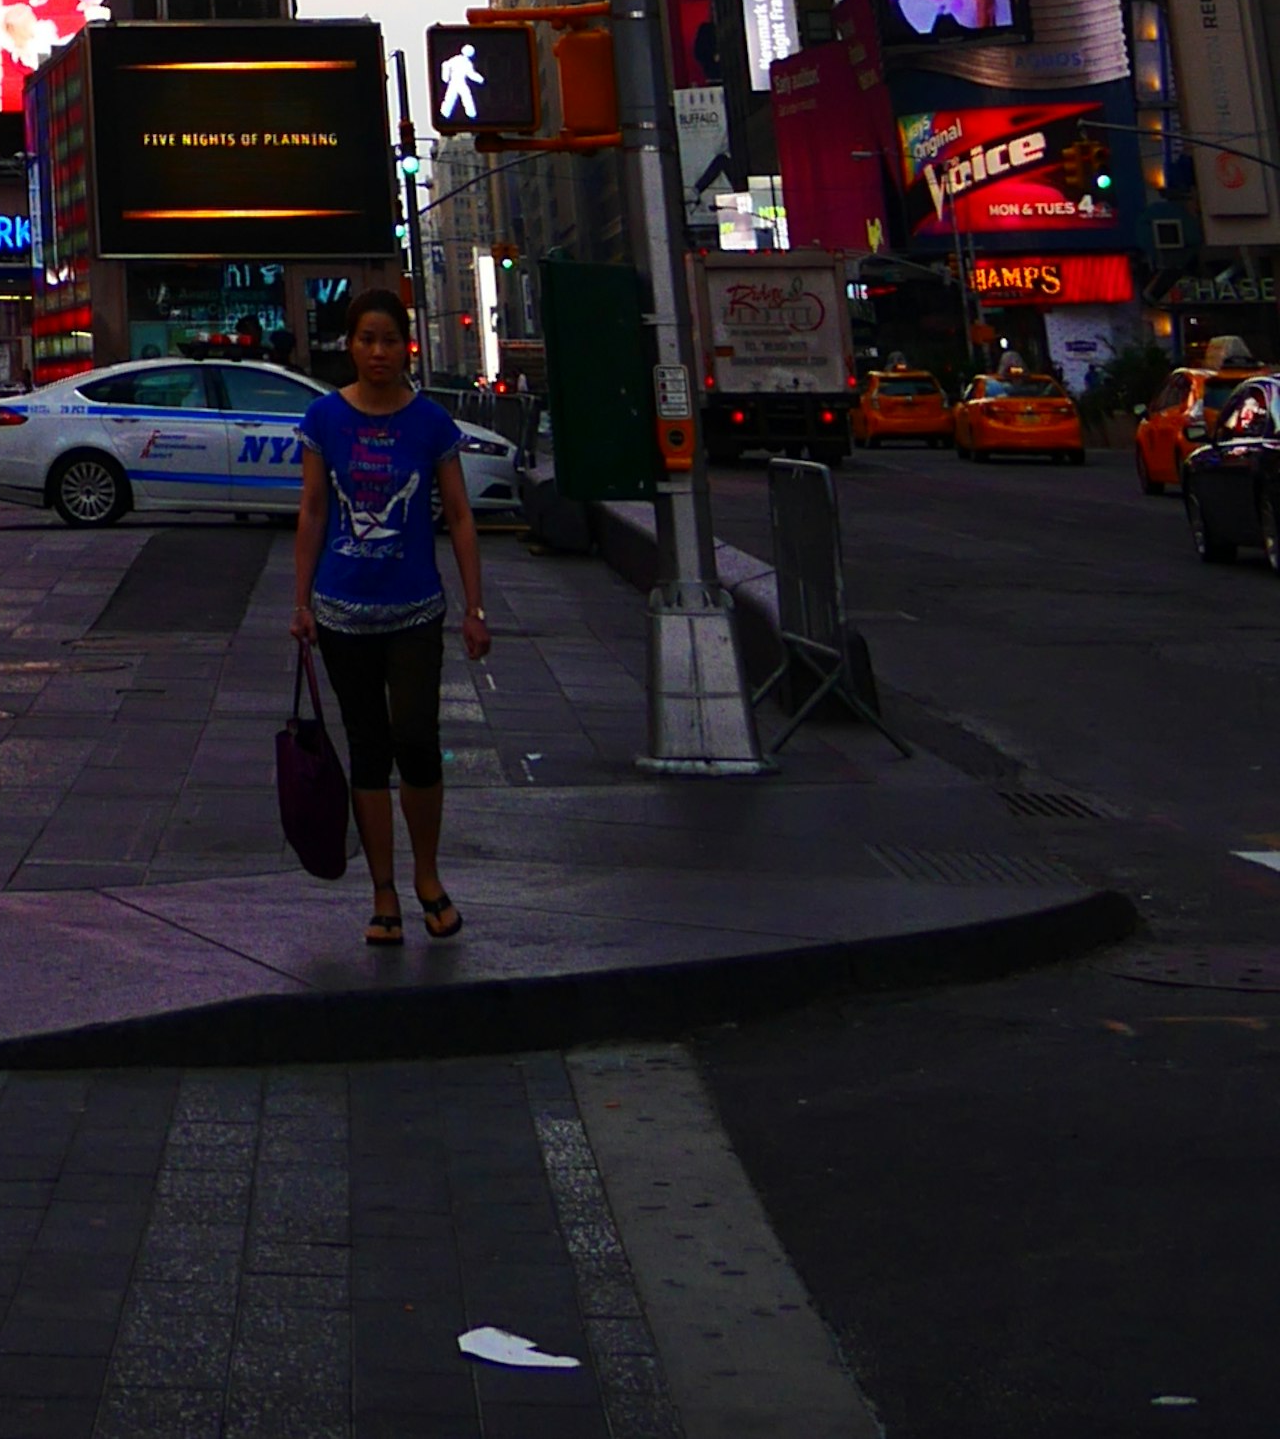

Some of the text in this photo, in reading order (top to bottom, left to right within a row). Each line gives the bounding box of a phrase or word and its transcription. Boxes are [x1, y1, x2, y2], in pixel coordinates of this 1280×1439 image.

[680, 111, 718, 125] BUFFALO
[143, 133, 338, 146] FIVE NIGHTS OF PLANNING
[914, 117, 963, 159] original
[989, 202, 1075, 216] MON & TUES
